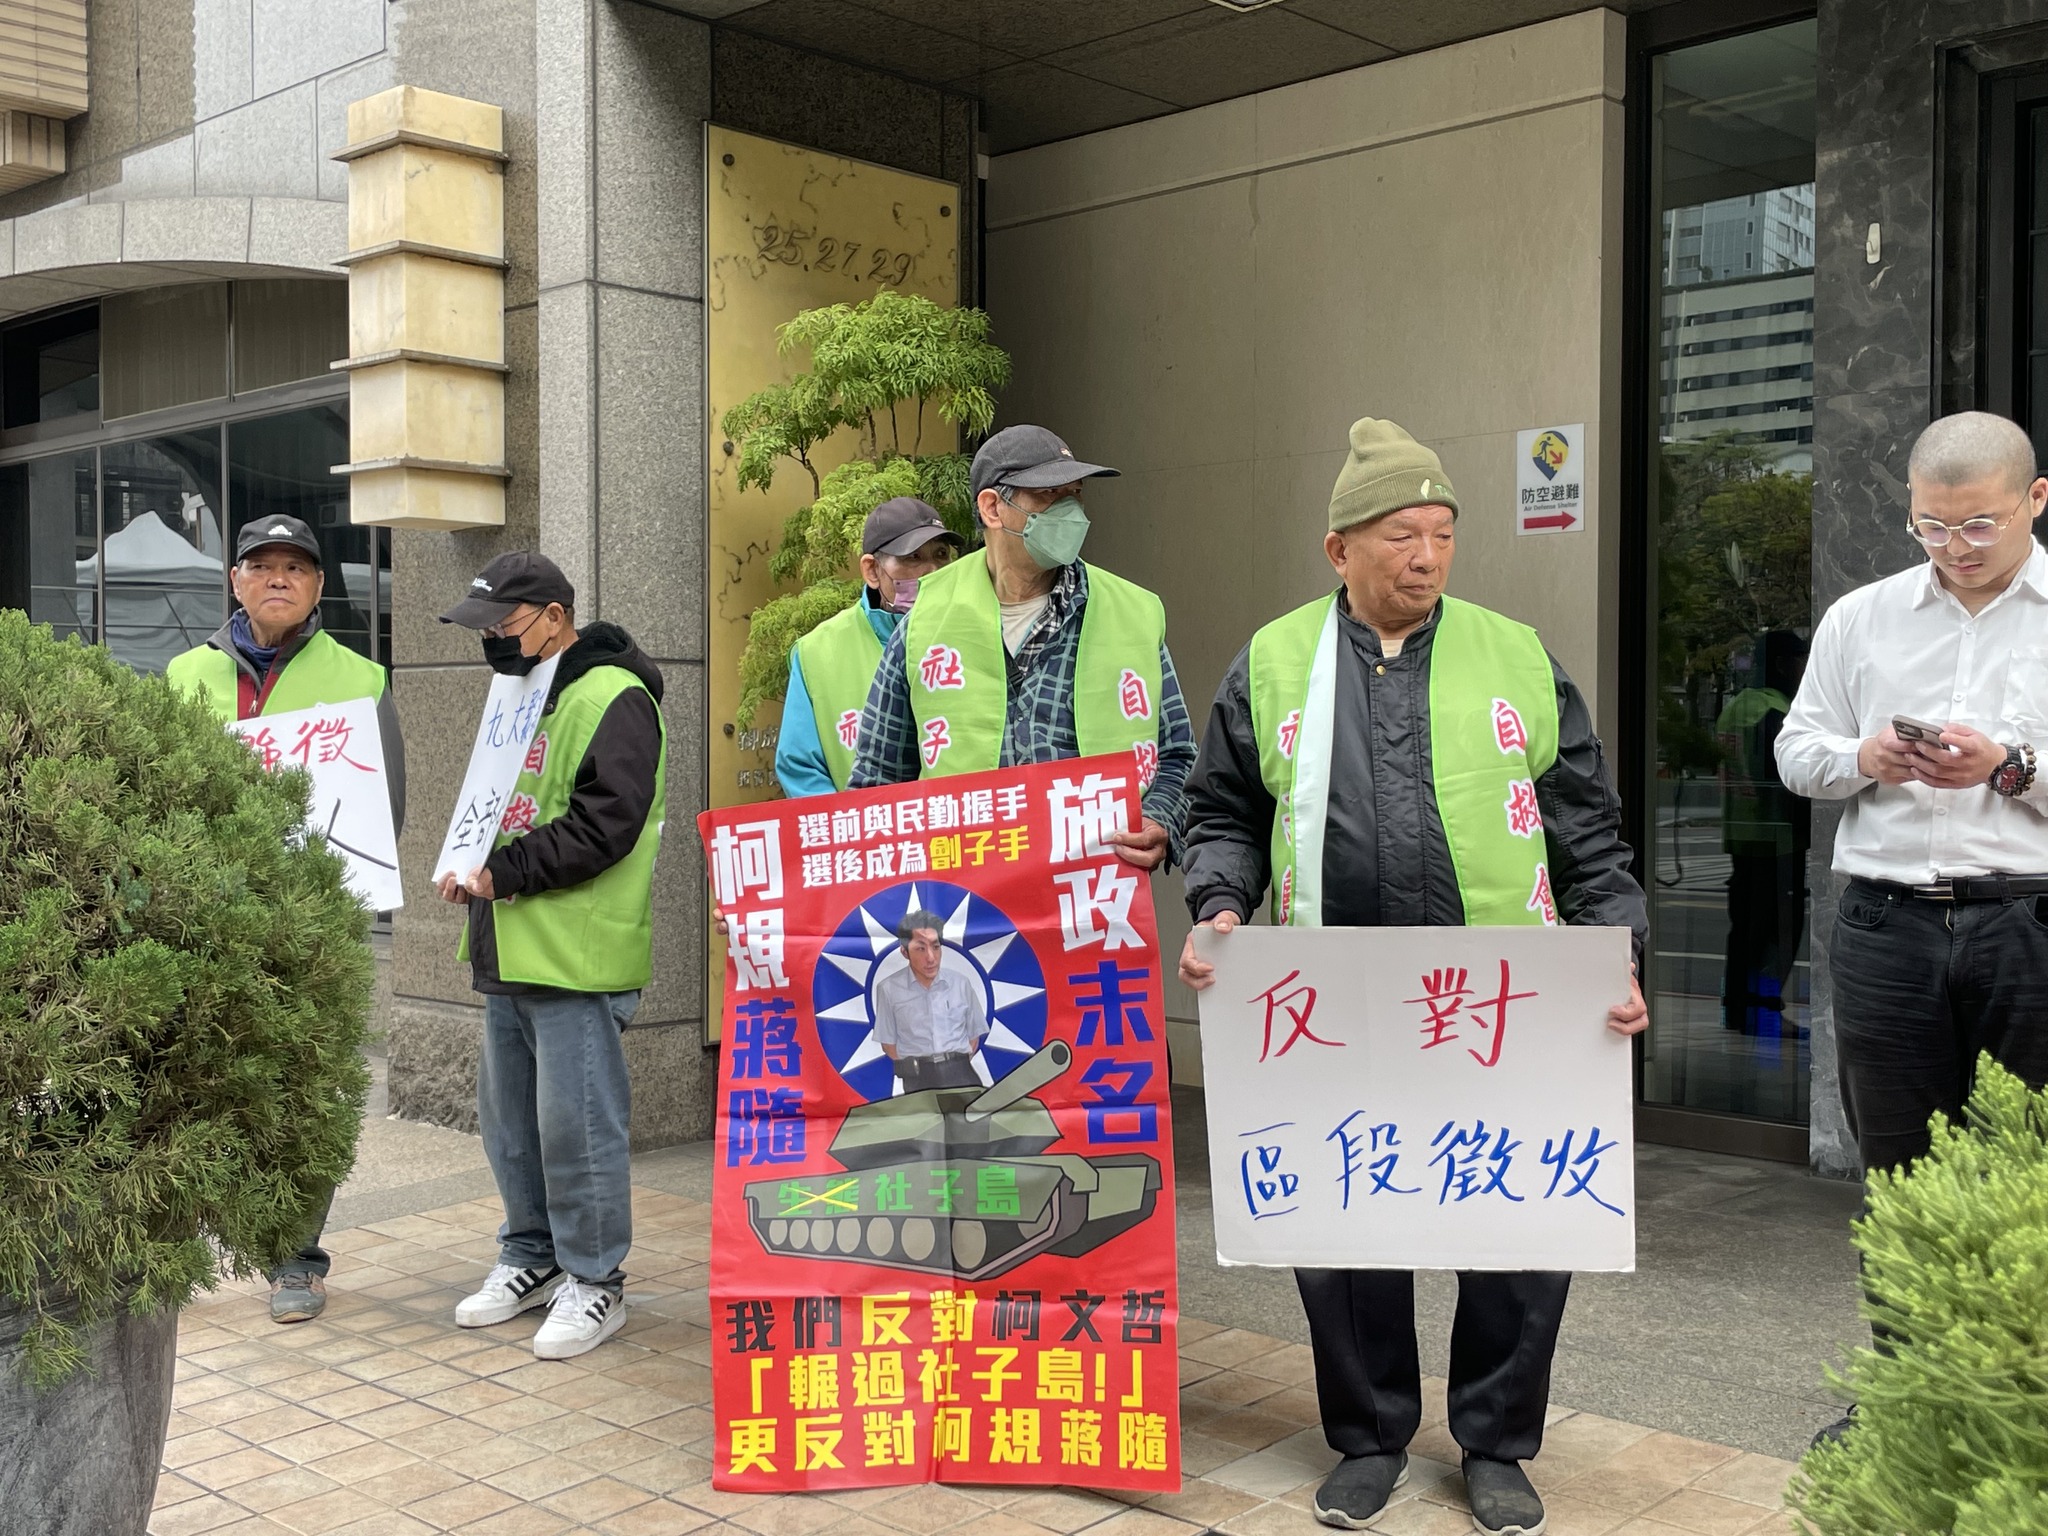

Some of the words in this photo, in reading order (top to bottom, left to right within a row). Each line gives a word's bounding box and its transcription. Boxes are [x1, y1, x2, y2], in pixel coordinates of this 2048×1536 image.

[1521, 483, 1579, 504] 防空避難
[920, 647, 965, 766] 社子
[798, 784, 1028, 849] 選前與民勤握手
[802, 825, 1030, 888] 選後成為劊子手
[711, 818, 807, 1168] 柯規蔣隨
[1046, 773, 1159, 1144] 施政末名
[1246, 959, 1539, 1067] 反對
[1238, 1109, 1626, 1221] 區段徵收
[726, 1289, 1166, 1353] 我們反對柯文哲
[728, 1407, 1168, 1474] 更反對柯規蔣隨
